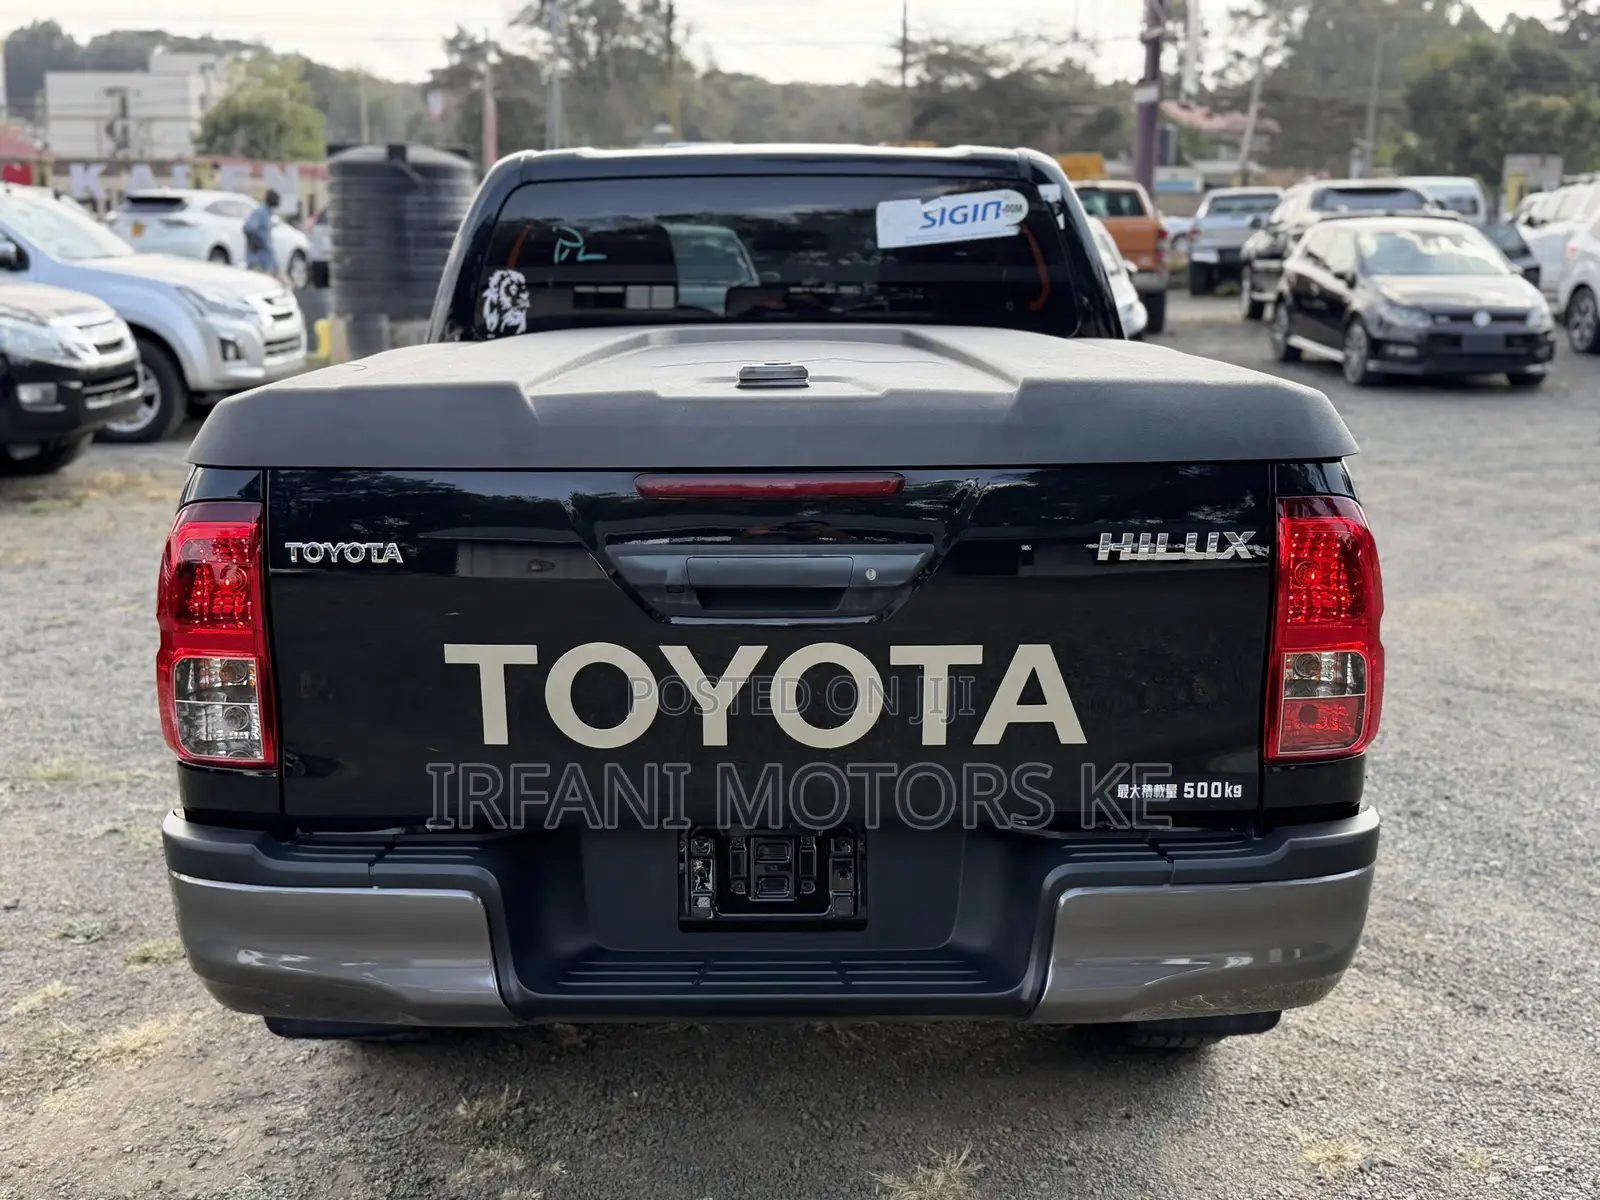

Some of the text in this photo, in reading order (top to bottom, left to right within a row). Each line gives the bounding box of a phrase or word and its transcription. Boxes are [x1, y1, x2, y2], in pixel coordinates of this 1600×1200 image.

[285, 542, 403, 563] TOYOTA
[1097, 531, 1256, 560] HILUX
[443, 642, 1087, 749] TOYOTA
[1183, 781, 1242, 798] 500kg
